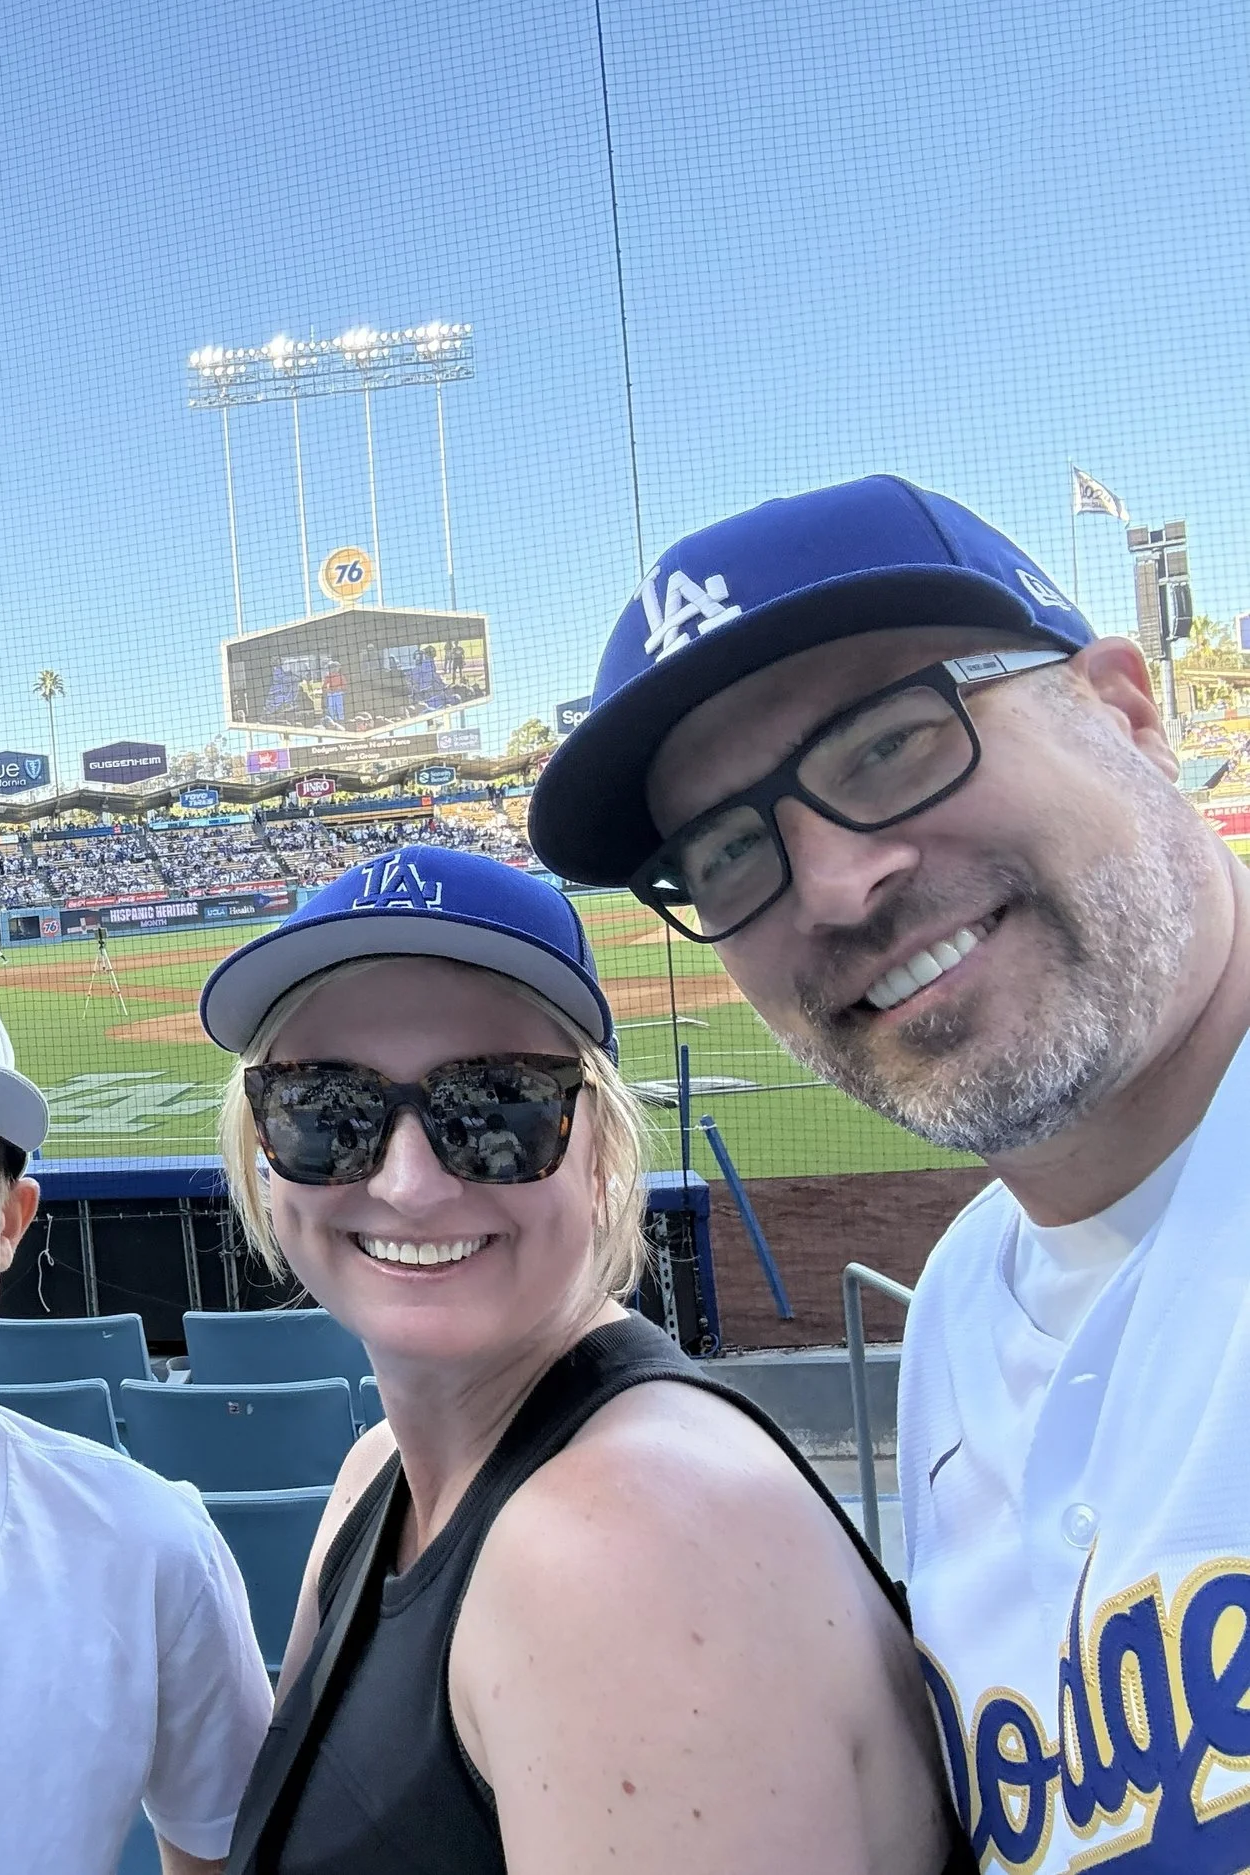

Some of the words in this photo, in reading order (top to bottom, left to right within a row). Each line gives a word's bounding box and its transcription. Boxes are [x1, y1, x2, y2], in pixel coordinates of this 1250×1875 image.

[334, 560, 364, 585] 76
[633, 564, 743, 663] LA
[89, 755, 162, 770] GUGGENHEIM
[302, 780, 330, 796] JINRO
[353, 853, 443, 911] LA
[110, 906, 155, 923] HISPANIC
[155, 902, 199, 919] HERITAGE
[207, 908, 226, 917] UCLA
[229, 905, 256, 916] Health
[43, 921, 59, 932] 76
[140, 919, 168, 928] MONTH
